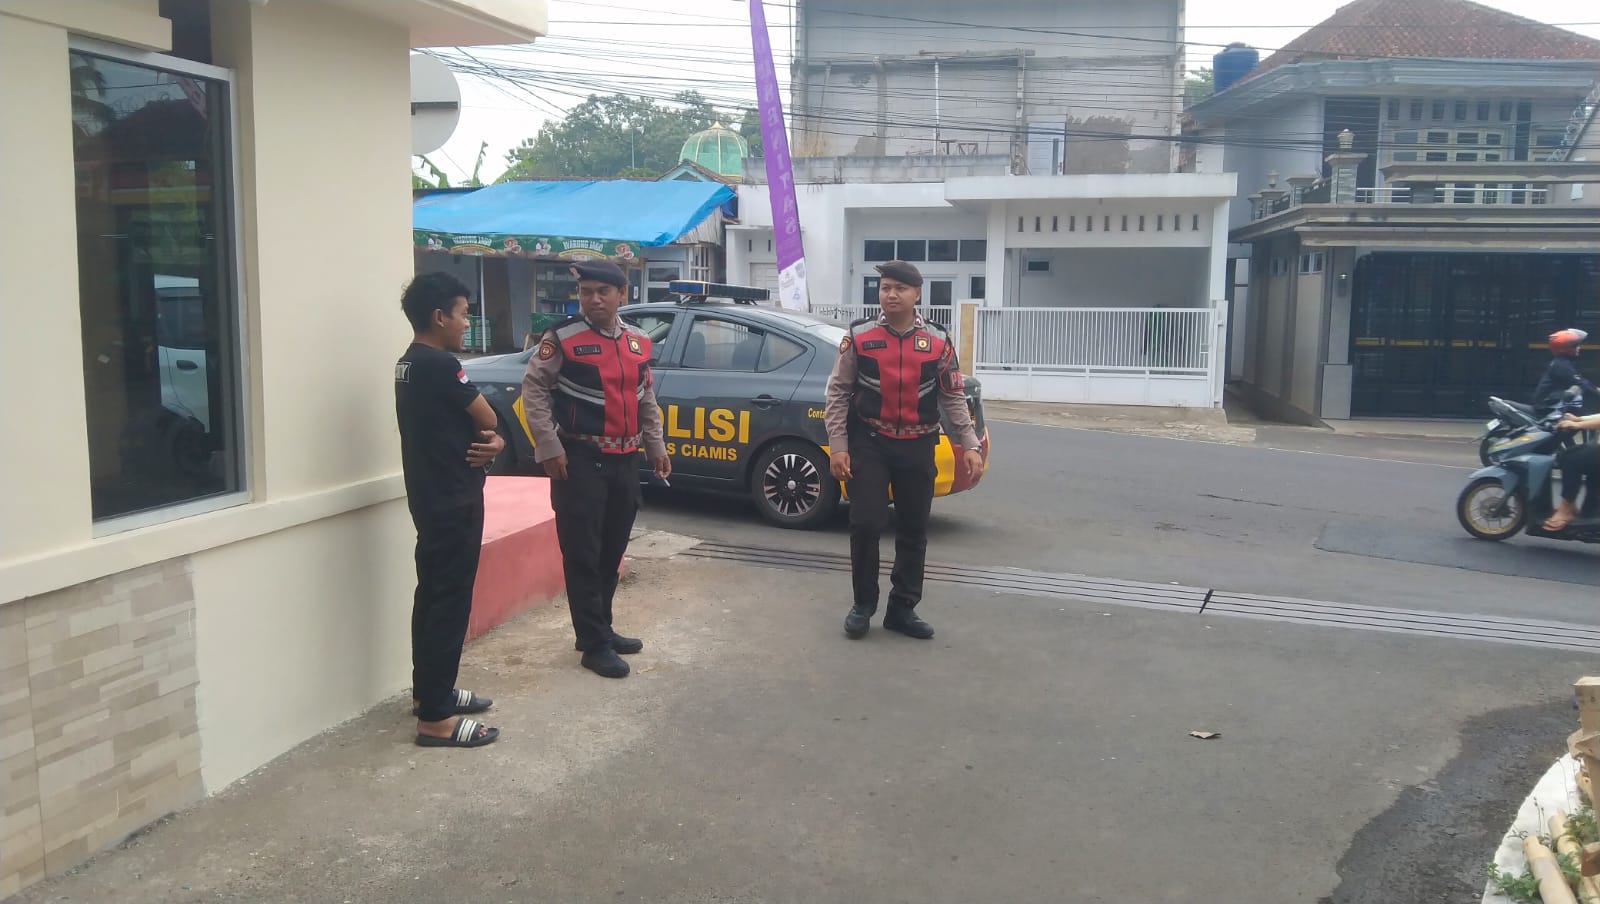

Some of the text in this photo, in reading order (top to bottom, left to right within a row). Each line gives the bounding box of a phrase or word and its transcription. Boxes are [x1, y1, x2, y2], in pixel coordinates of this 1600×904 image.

[563, 239, 589, 250] WARUNG
[808, 407, 827, 419] Conta
[657, 404, 750, 444] LISI
[681, 443, 738, 461] CIAMIS
